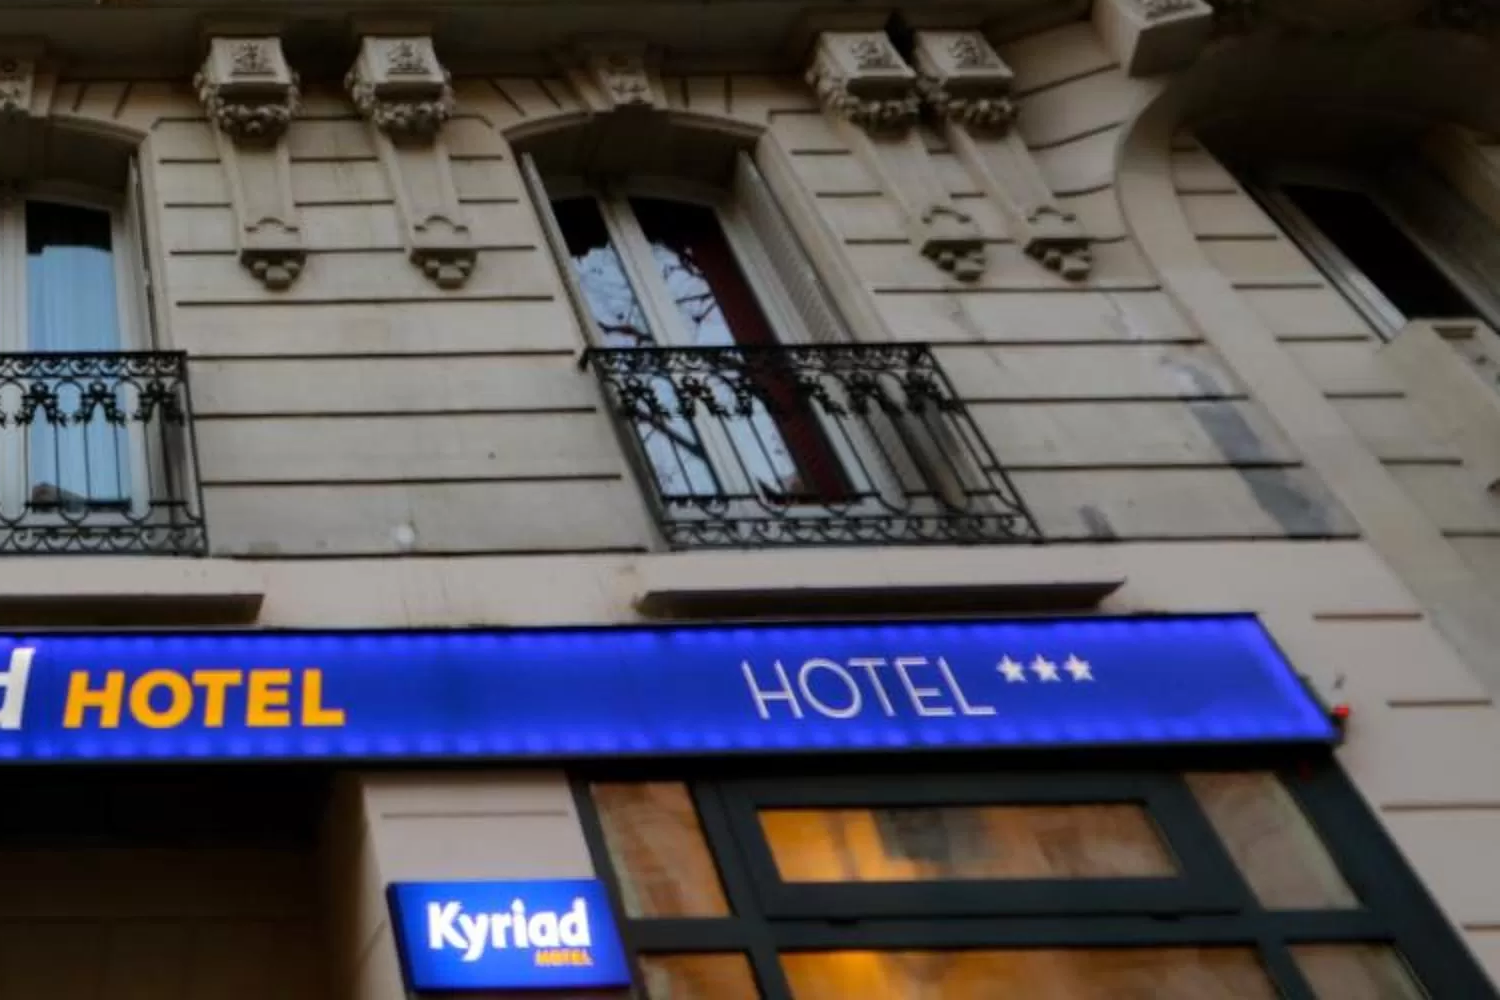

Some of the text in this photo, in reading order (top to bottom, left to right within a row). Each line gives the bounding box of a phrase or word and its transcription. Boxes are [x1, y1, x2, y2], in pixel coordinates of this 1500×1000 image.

[62, 668, 346, 729] HOTEL
[741, 656, 996, 719] HOTEL
[427, 897, 591, 961] Kyriad
